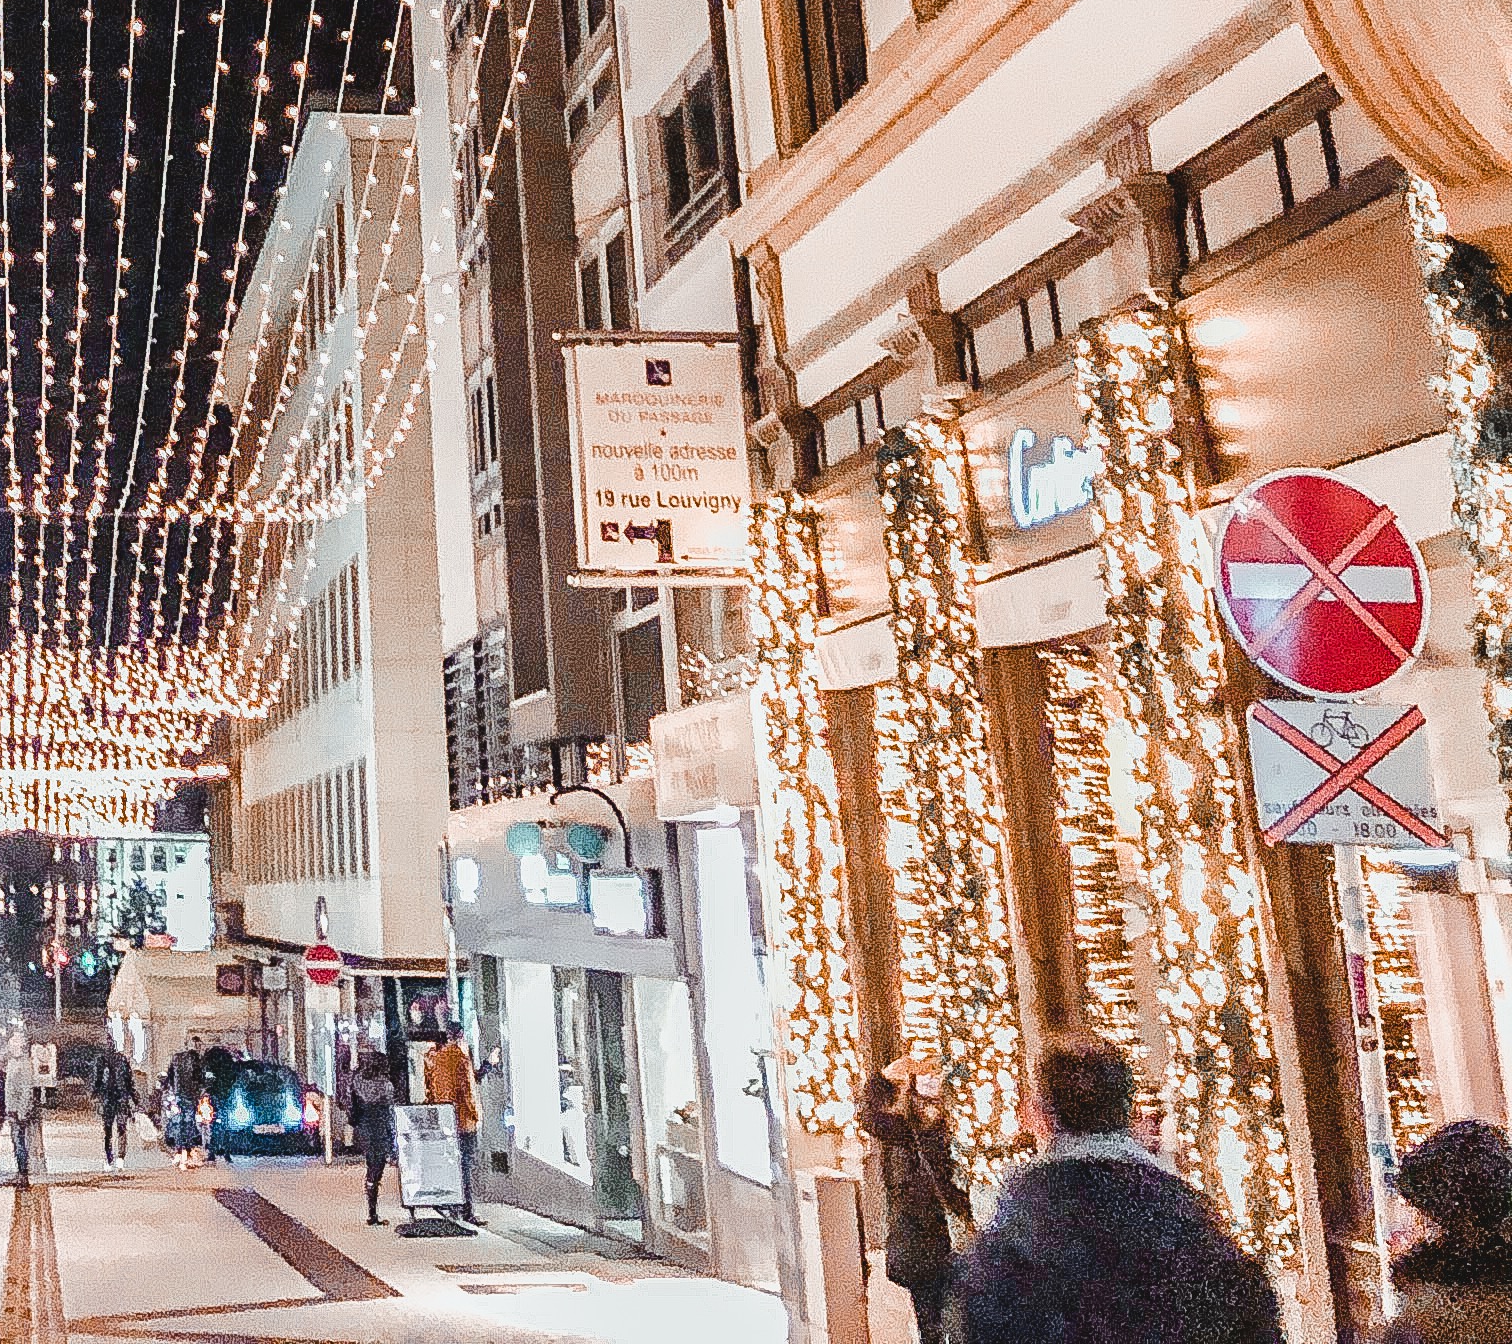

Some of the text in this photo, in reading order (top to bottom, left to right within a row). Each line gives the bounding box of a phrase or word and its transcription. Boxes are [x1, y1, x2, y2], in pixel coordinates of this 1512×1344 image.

[638, 411, 713, 425] PASSAGE
[591, 442, 737, 460] nouvelle adresse
[652, 464, 699, 481] 100m
[595, 489, 742, 513] 19 rue Louvigny
[1354, 822, 1397, 838] 18.00
